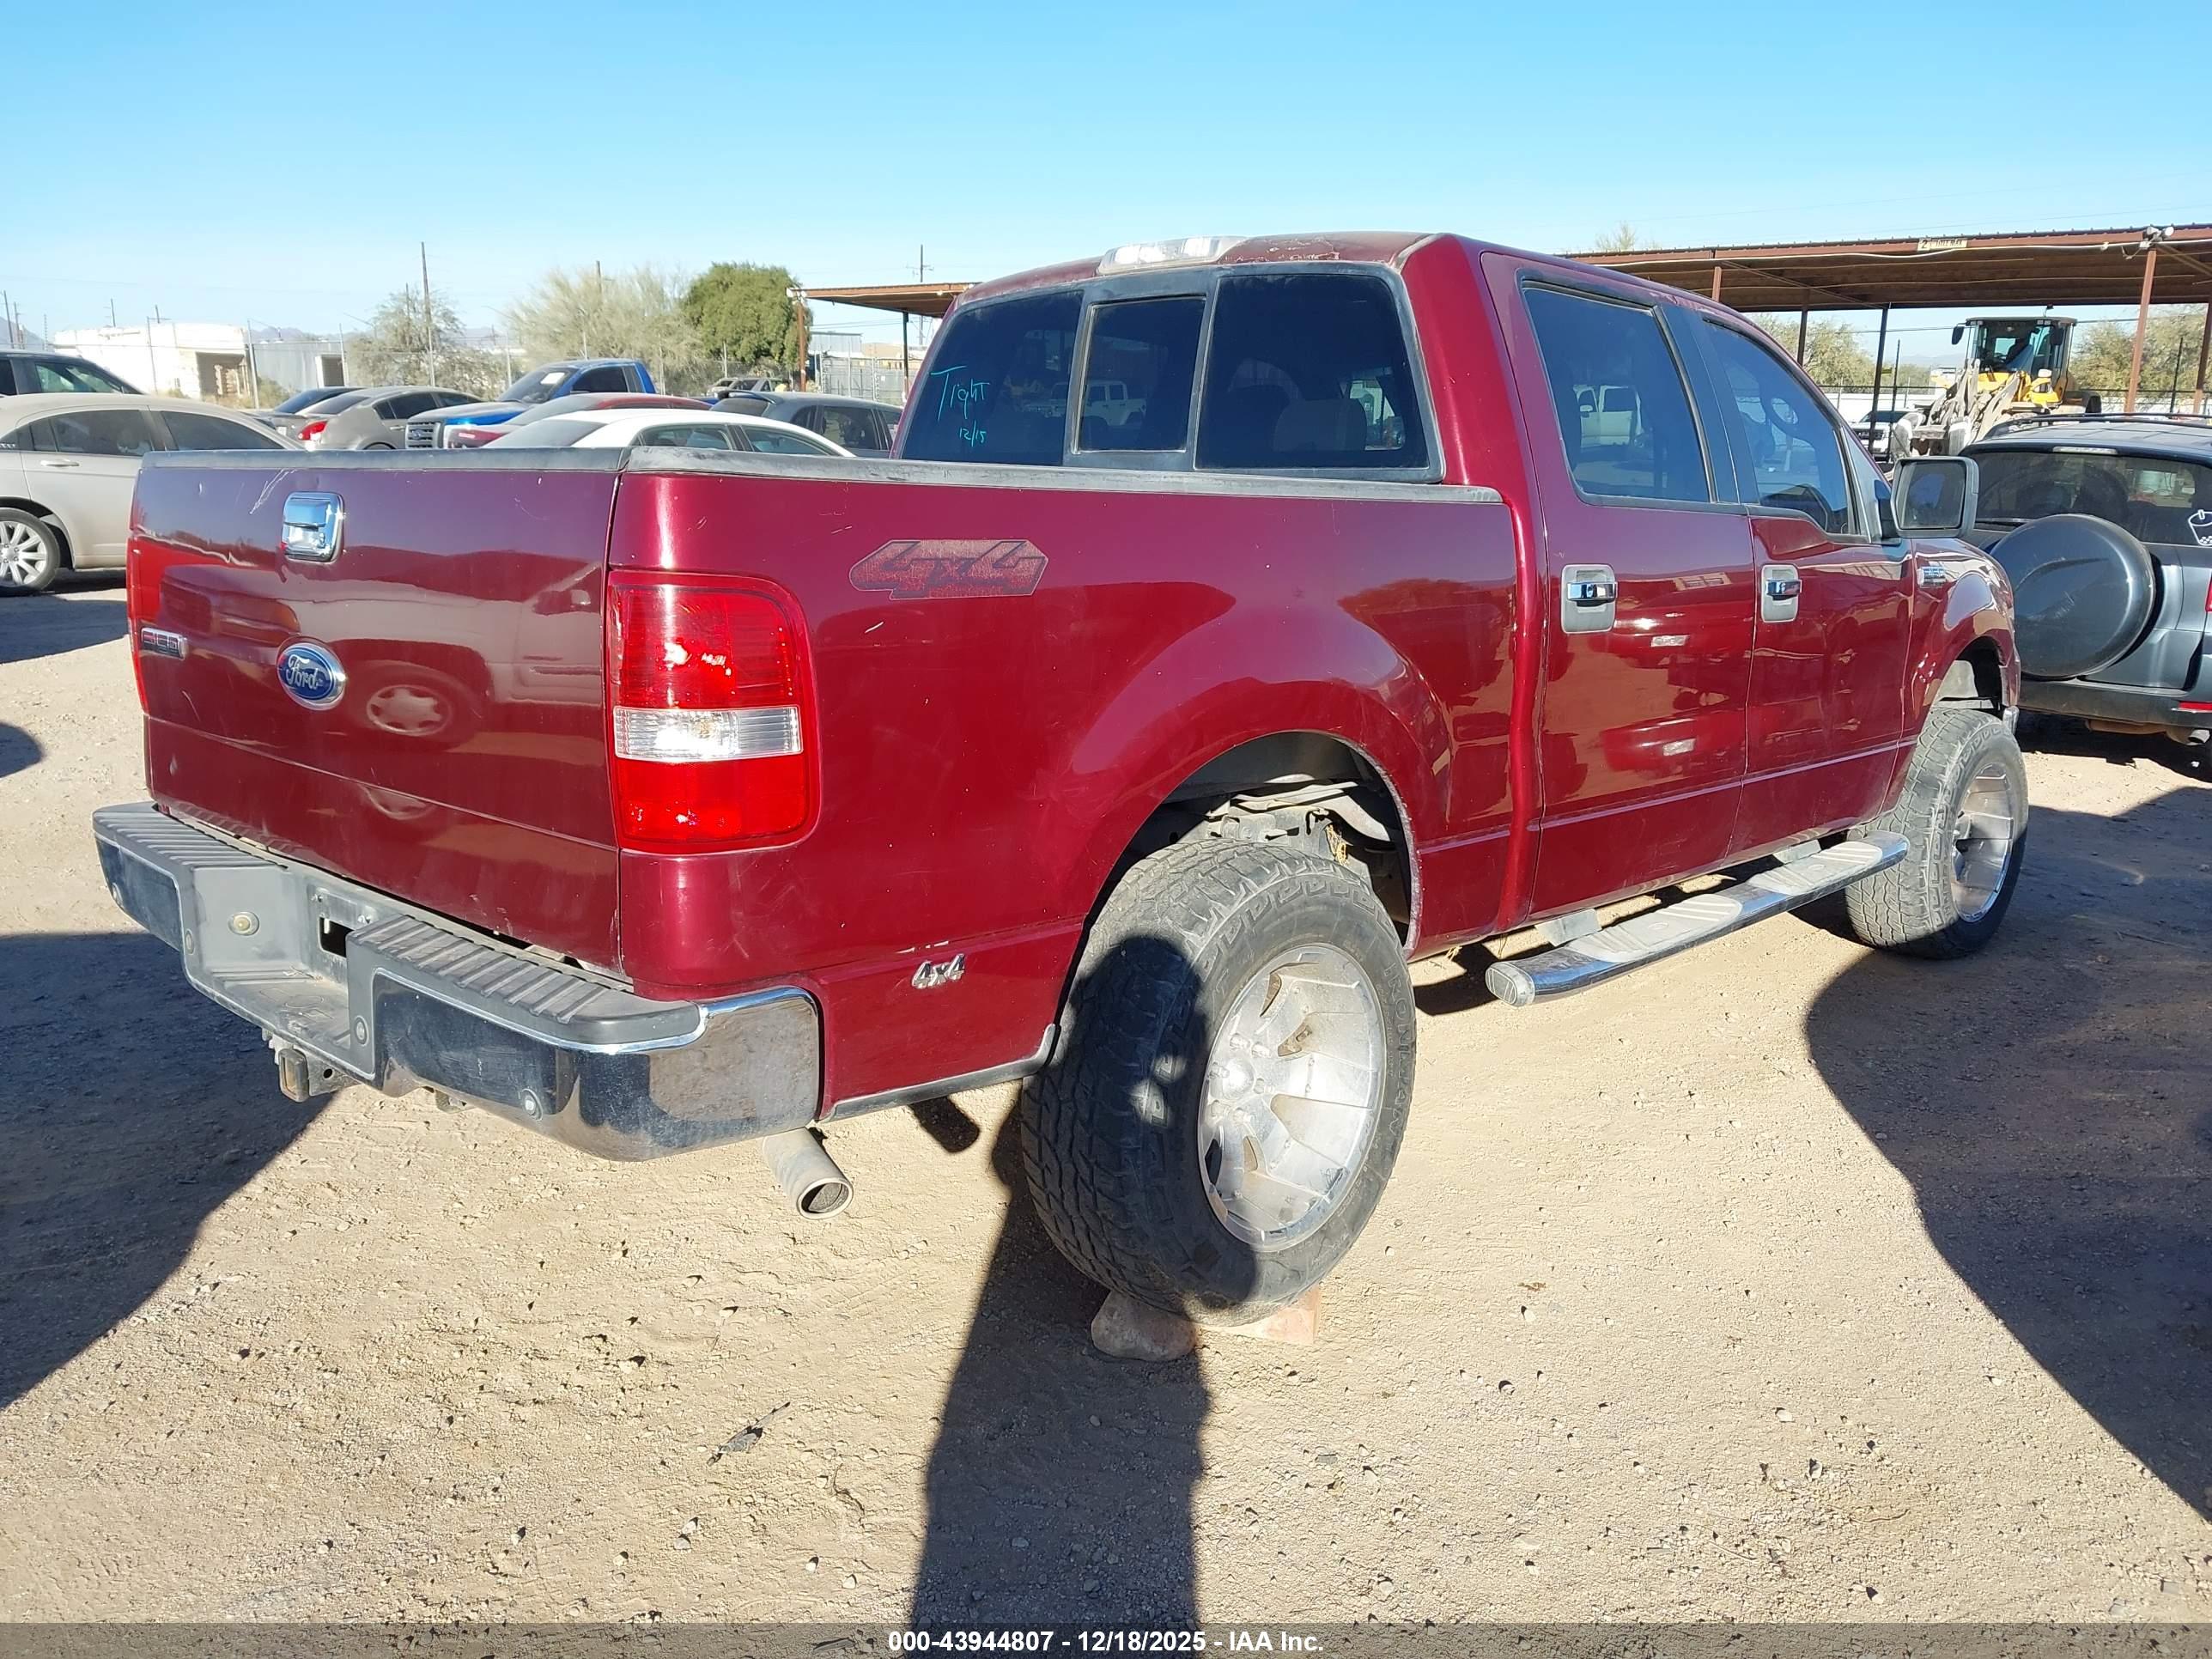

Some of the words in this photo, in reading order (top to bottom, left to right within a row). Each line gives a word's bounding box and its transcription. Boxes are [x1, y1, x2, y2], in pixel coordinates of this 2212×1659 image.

[959, 419, 987, 447] 12/15
[285, 653, 325, 690] Ford
[911, 952, 965, 990] 4x4
